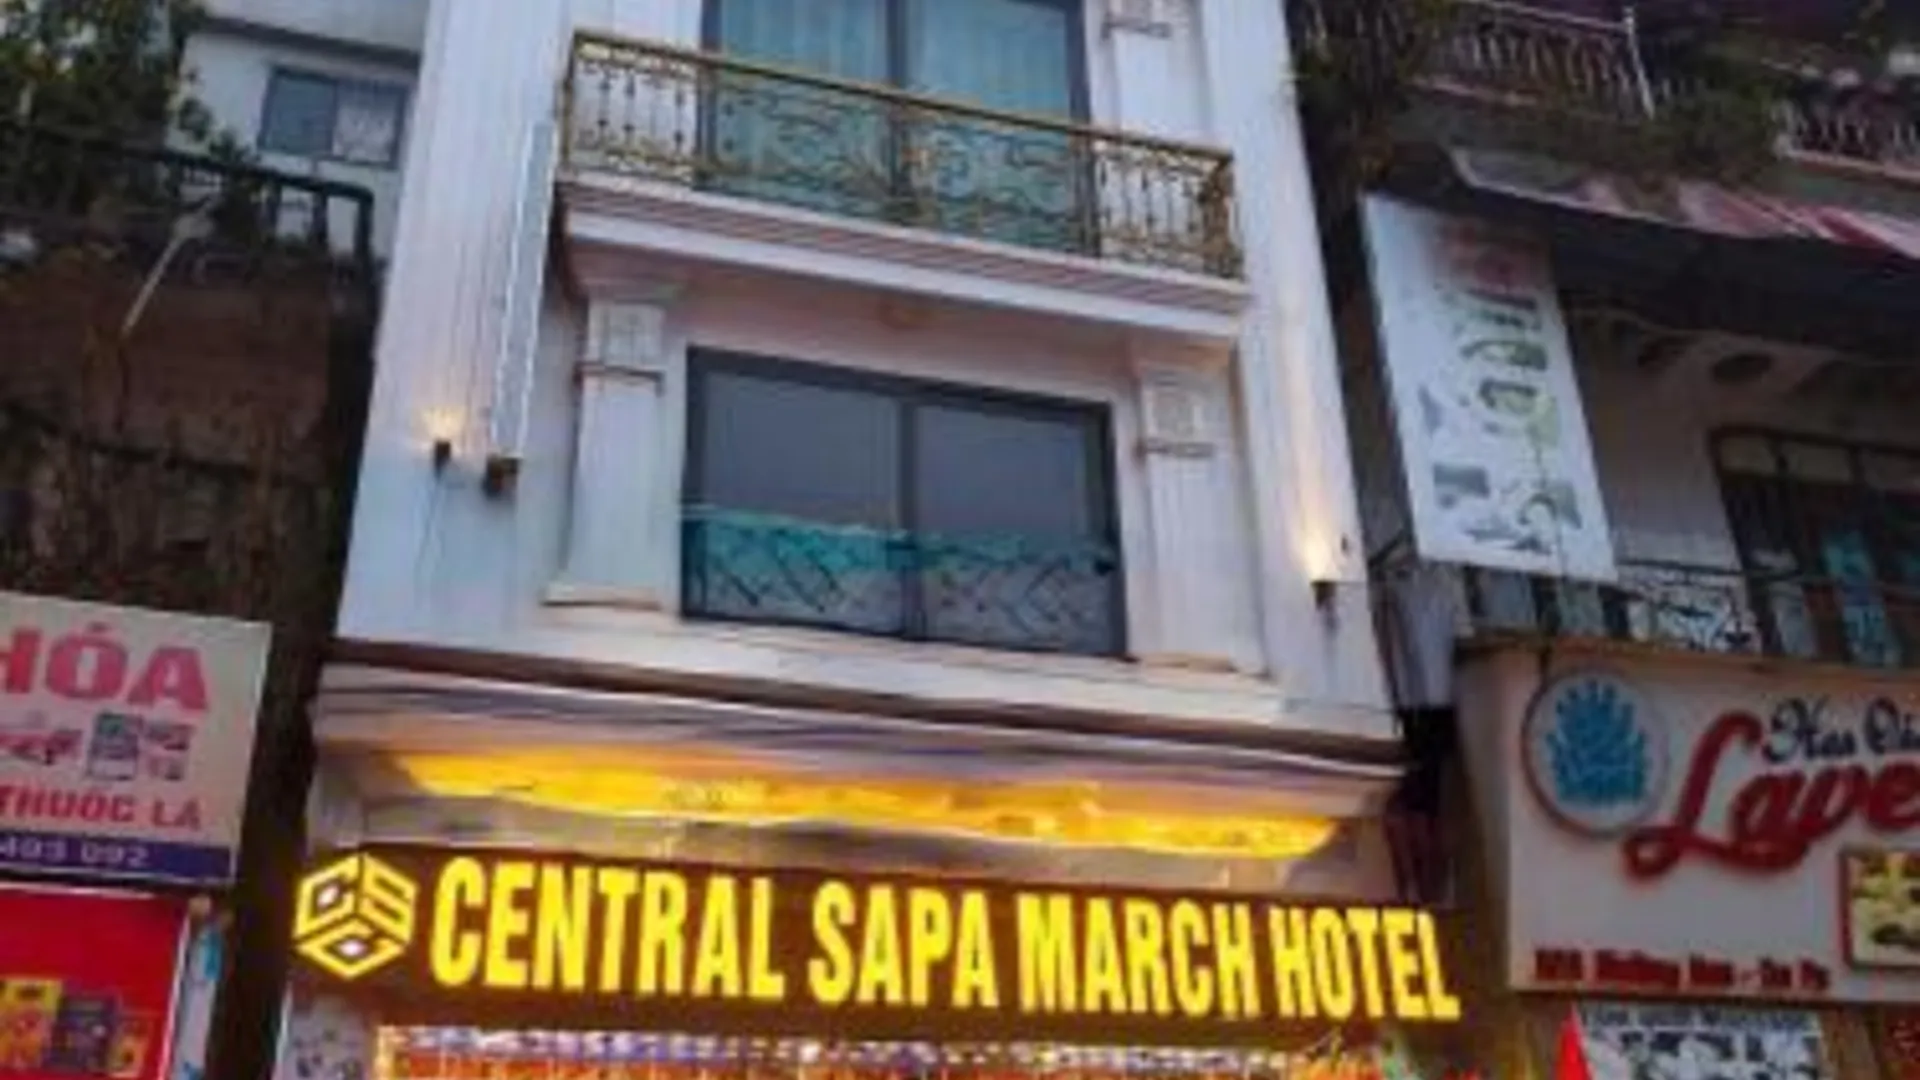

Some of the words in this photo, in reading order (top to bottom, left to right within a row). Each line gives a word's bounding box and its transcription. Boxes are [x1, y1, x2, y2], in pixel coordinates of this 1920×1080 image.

[430, 857, 786, 1000] CENTRAL
[808, 881, 999, 1006] SAPA
[1016, 892, 1261, 1017] MARCH
[1268, 904, 1461, 1020] HOTEL
